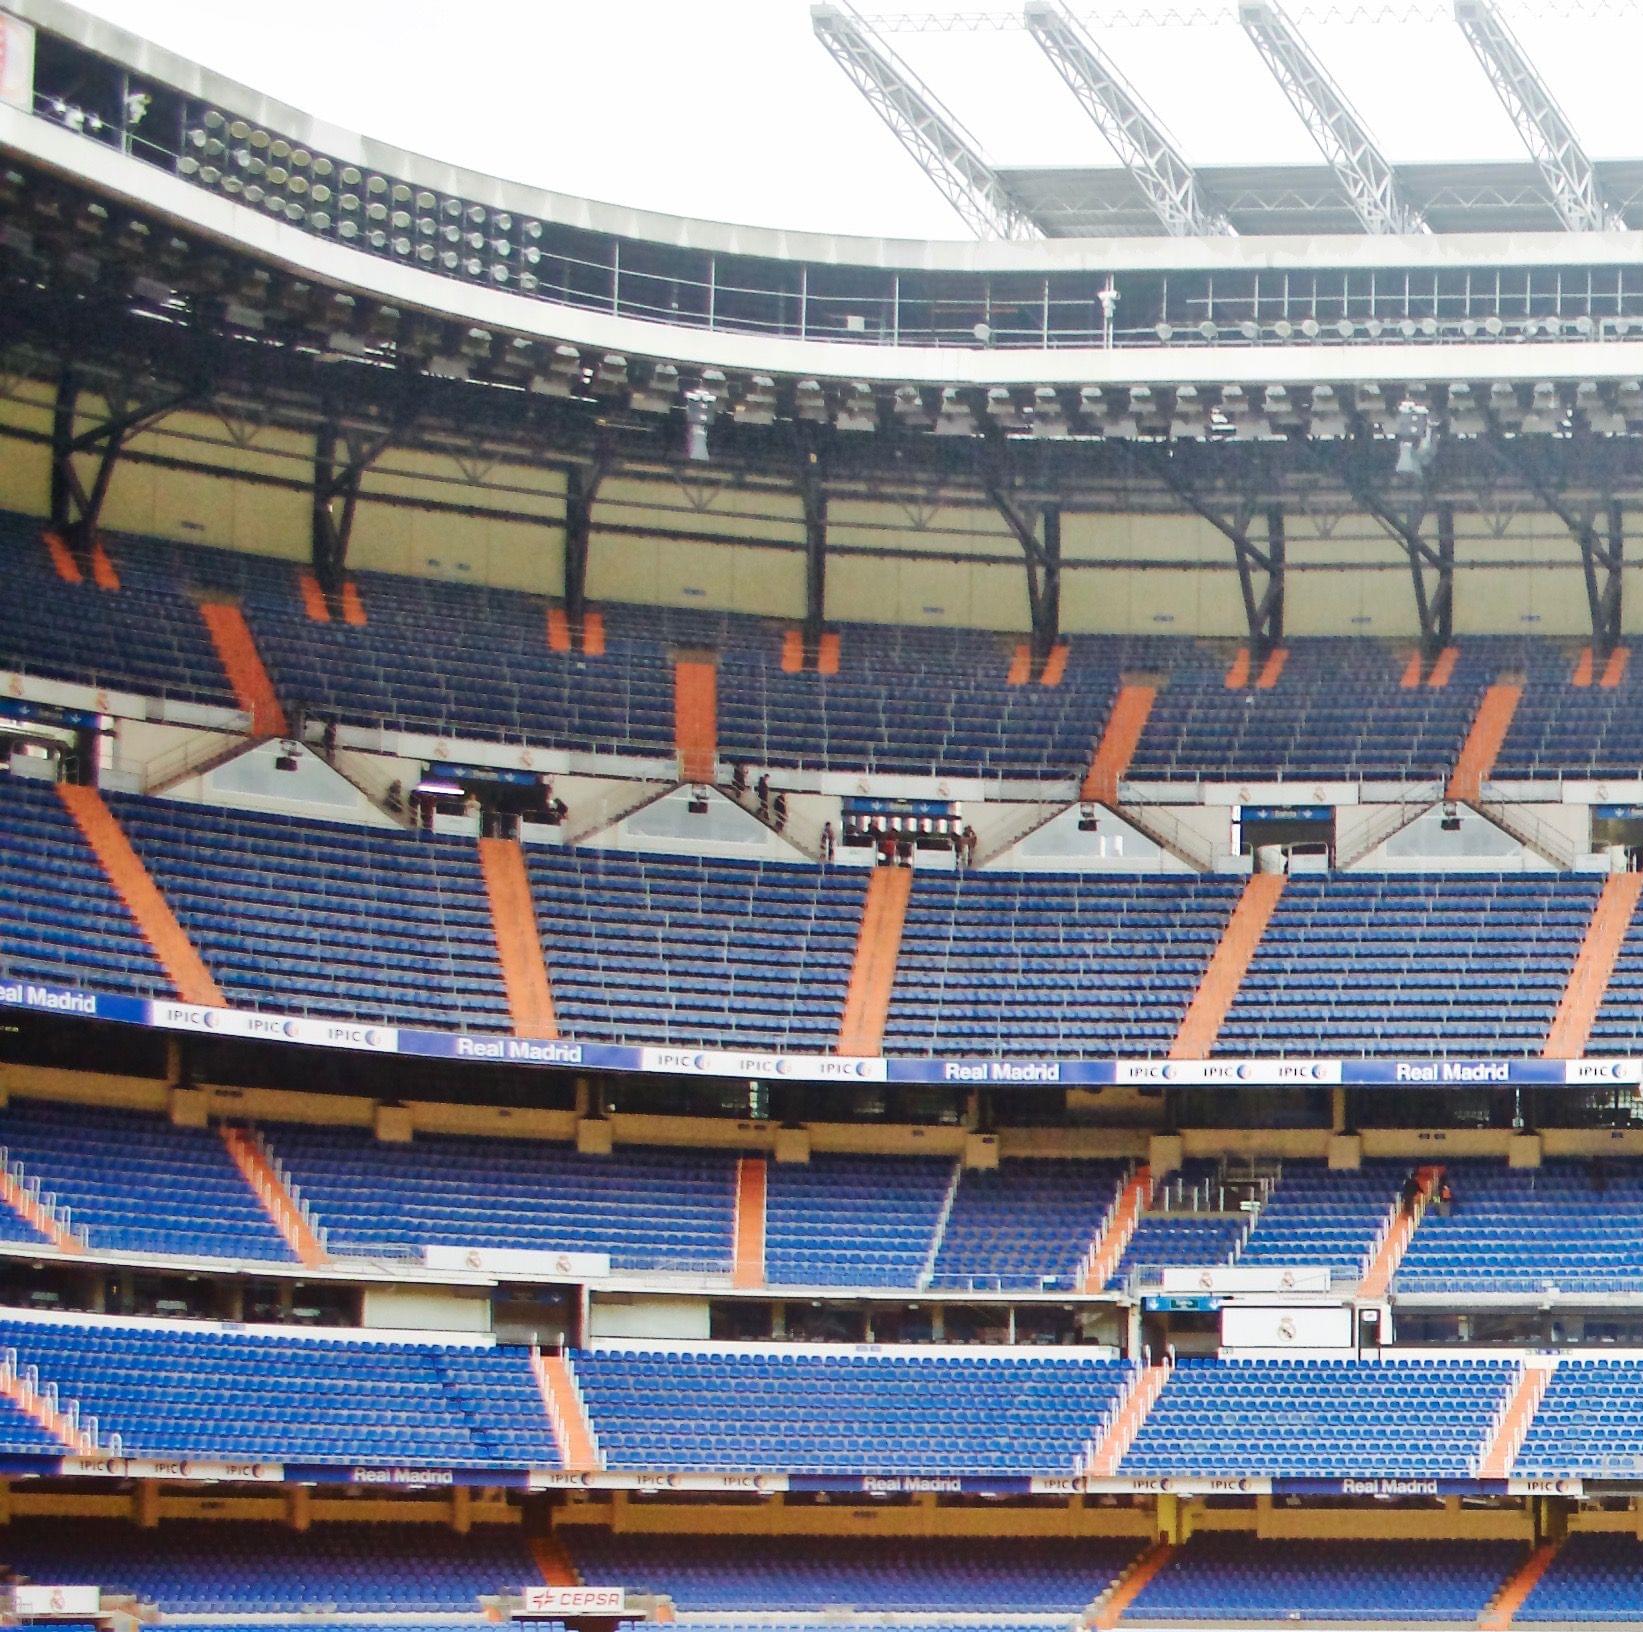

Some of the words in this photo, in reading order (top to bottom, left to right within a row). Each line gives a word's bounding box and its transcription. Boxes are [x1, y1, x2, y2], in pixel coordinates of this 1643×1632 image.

[0, 984, 23, 1003] eal
[28, 988, 96, 1014] Madrid
[169, 1010, 198, 1023] IPIC
[249, 1021, 279, 1034] IPIC
[329, 1029, 359, 1042] IPIC
[457, 1038, 505, 1057] Real
[508, 1040, 583, 1063] Madrid
[659, 1055, 688, 1067] IPIC
[741, 1060, 769, 1071] IPIC
[821, 1063, 849, 1075] IPIC
[945, 1063, 987, 1080] Real
[992, 1063, 1059, 1081] Madrid
[1131, 1067, 1159, 1078] IPIC
[1205, 1067, 1233, 1078] IPIC
[1280, 1066, 1308, 1078] IPIC
[1397, 1064, 1437, 1081] Real
[1443, 1062, 1508, 1082] Madrid
[1580, 1066, 1608, 1078] IPIC
[353, 1467, 392, 1482] Real
[394, 1469, 453, 1485] Madrid
[864, 1476, 900, 1493] Real
[904, 1478, 961, 1493] Madrid
[1344, 1479, 1382, 1496] Real
[1382, 1477, 1436, 1496] Madrid
[560, 1591, 620, 1606] CEPSA
